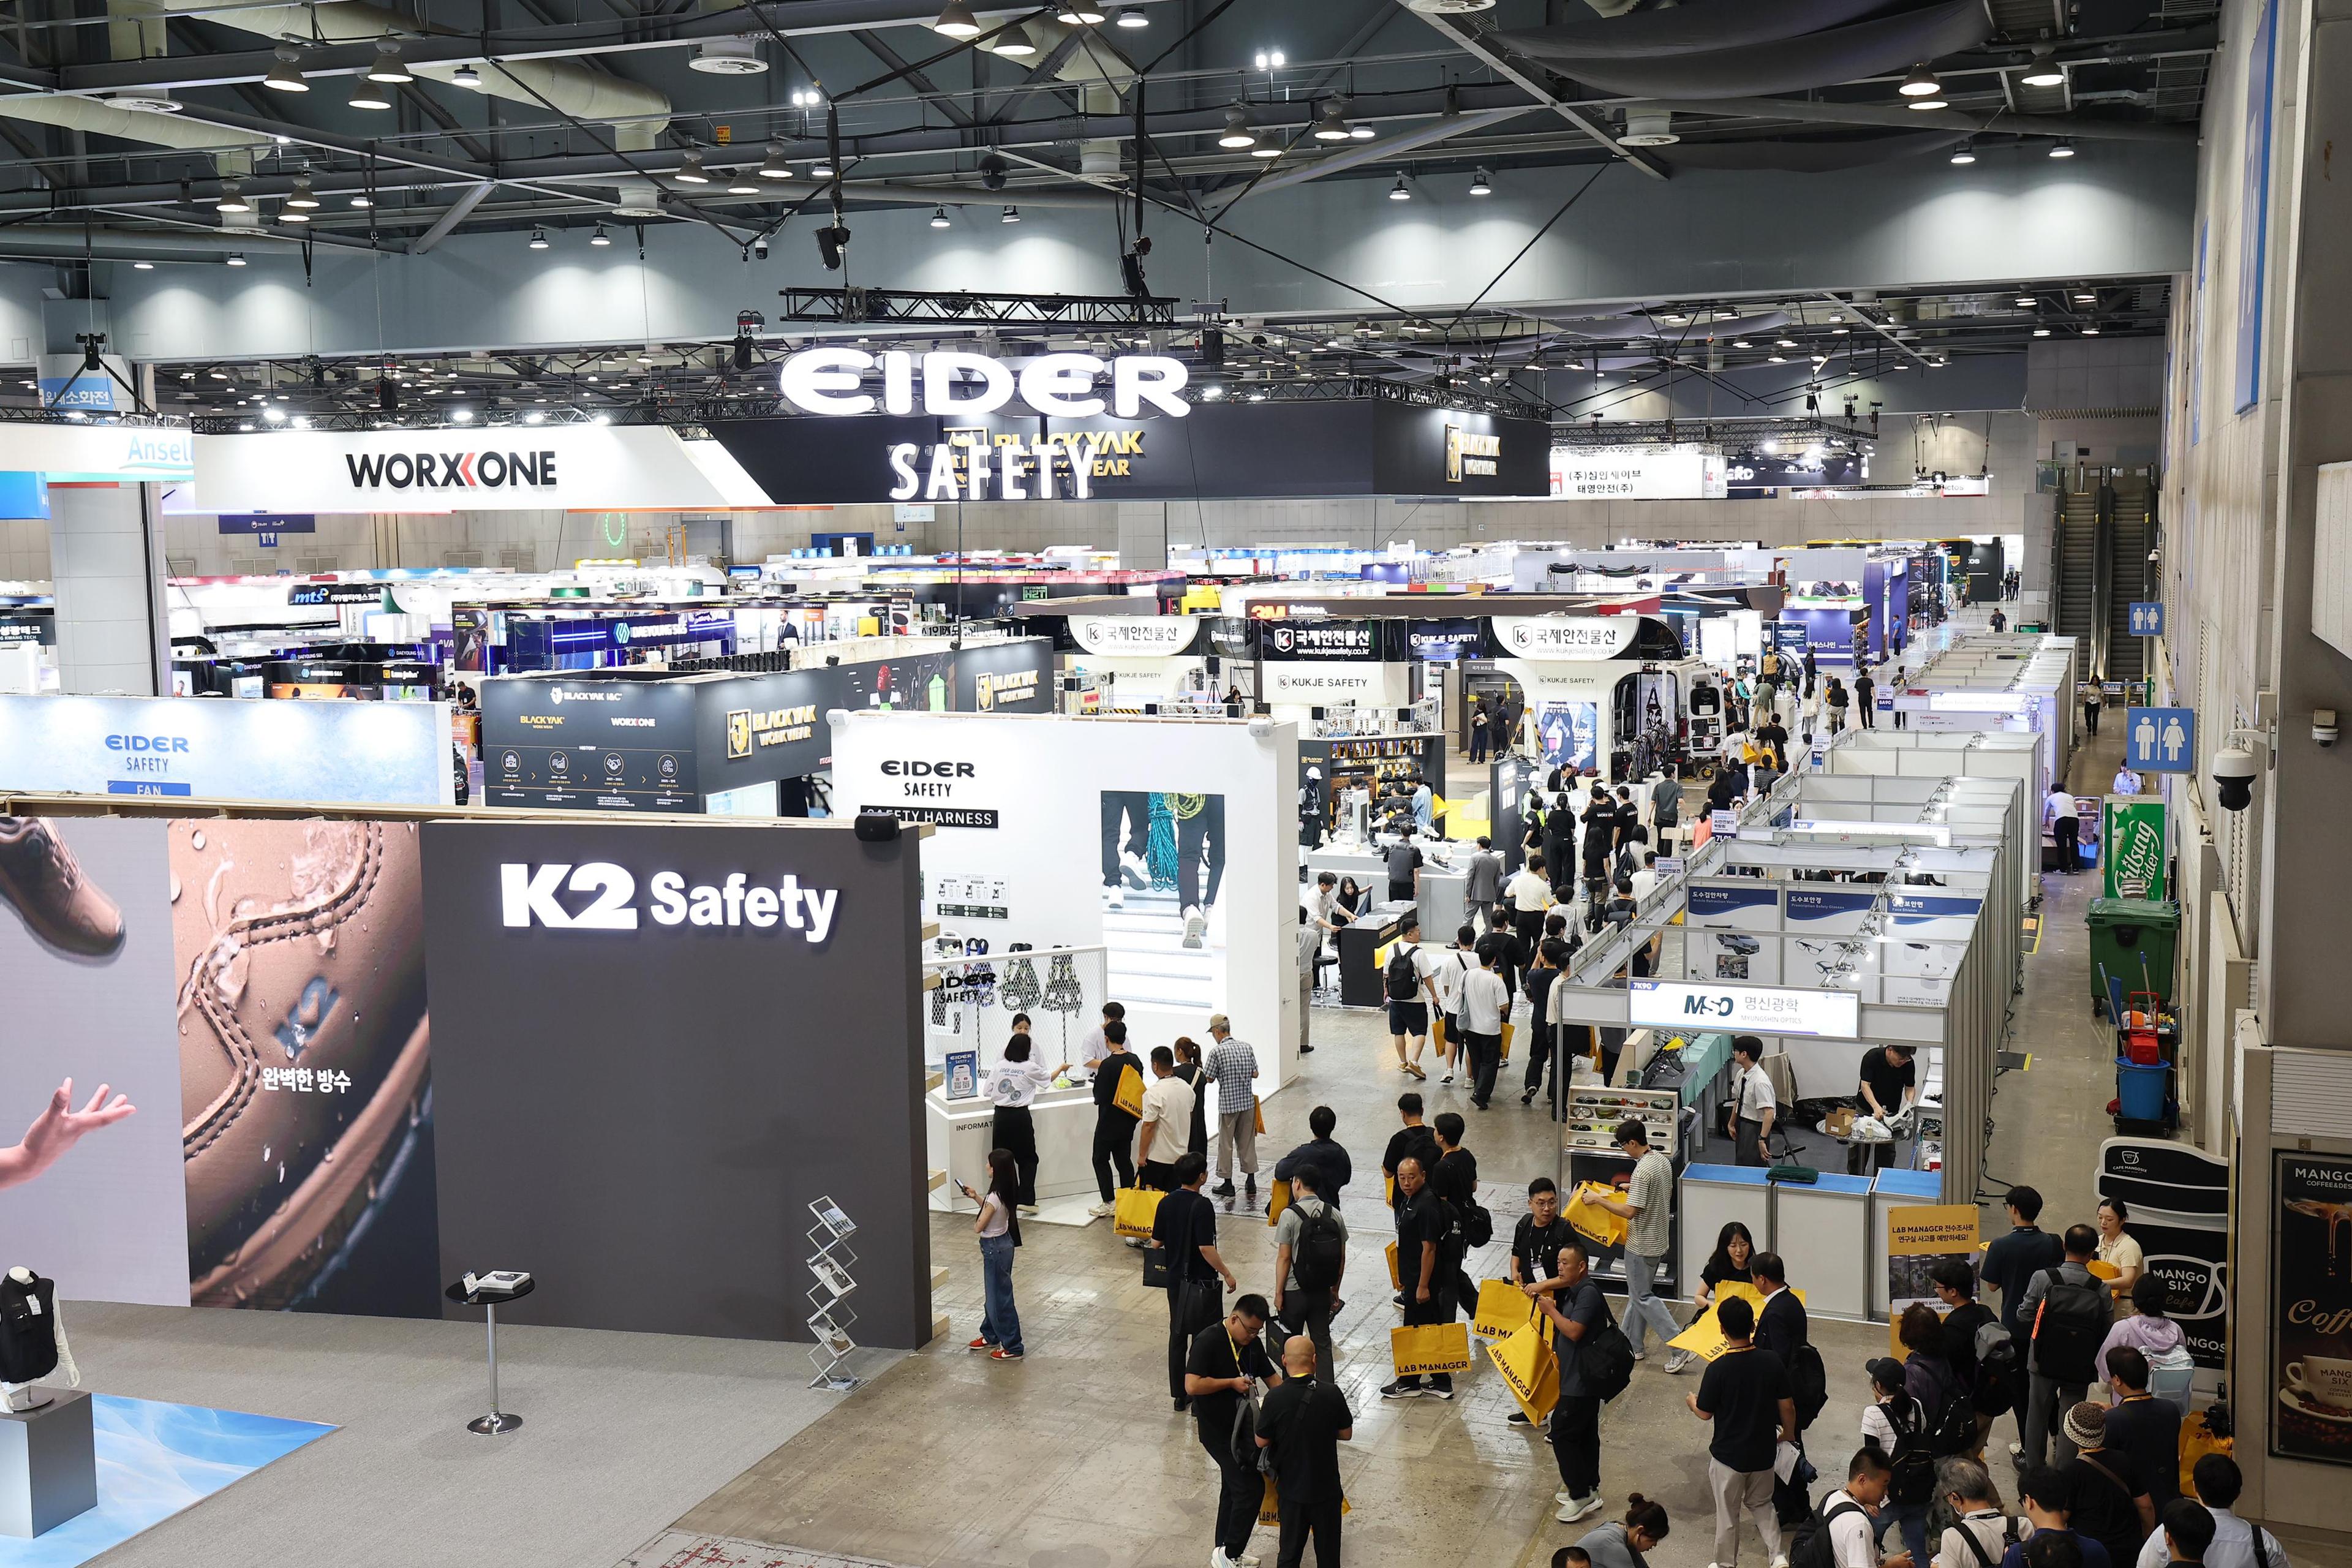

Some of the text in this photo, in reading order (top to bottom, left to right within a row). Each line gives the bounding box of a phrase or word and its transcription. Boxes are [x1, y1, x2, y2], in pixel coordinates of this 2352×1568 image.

[780, 347, 1191, 418] EIDER
[127, 435, 195, 461] Ansell
[889, 443, 1097, 500] SAFETY
[1577, 484, 1633, 494] 태영안전(주)
[1251, 605, 1287, 619] 3M
[1107, 626, 1177, 641] 국제안전물산
[1296, 630, 1370, 646] 국제안전물산
[1447, 633, 1478, 643] SAFETY
[1537, 628, 1616, 645] 국제안전물산
[1297, 647, 1370, 657] www.kukjesafety.co.kr
[1536, 646, 1616, 655] www.kukjesafety.co.kr
[1292, 677, 1367, 687] KUKJE SAFETY
[519, 715, 565, 725] BLACKYAK
[752, 704, 817, 732] BLACKYAK
[105, 734, 190, 753] EIDER
[126, 757, 169, 774] SAFETY
[880, 760, 975, 778] EIDER
[137, 784, 162, 796] FAN
[904, 782, 952, 797] SAFETY
[867, 809, 992, 826] ETY HARNESS
[500, 862, 638, 930] K2
[1692, 891, 1728, 901] 도수검안차량
[1790, 896, 1822, 906] 도수보안경
[650, 870, 840, 943] Safety
[933, 972, 997, 989] IDER
[939, 990, 979, 1004] SAFETY
[1744, 995, 1799, 1014] 명신광학
[1741, 1014, 1802, 1025] MYUNGSHIN OPTICS
[262, 1068, 352, 1094] 완벽한 방수
[1120, 1096, 1128, 1105] LAB
[956, 1121, 993, 1131] INFORMAT
[2295, 1167, 2352, 1183] MANGO
[1944, 1224, 1975, 1232] 전수조사로
[1937, 1234, 1969, 1243] 예방하세요!
[2153, 1269, 2207, 1284] MANGO
[2168, 1281, 2192, 1292] SIX
[2288, 1299, 2352, 1334] Coff
[1476, 1324, 1495, 1336] LAB
[1705, 1346, 1723, 1359] LAB
[1398, 1360, 1468, 1374] LAB MANAGER
[1500, 1359, 1531, 1399] MANAGER
[1259, 1511, 1270, 1521] LAB
